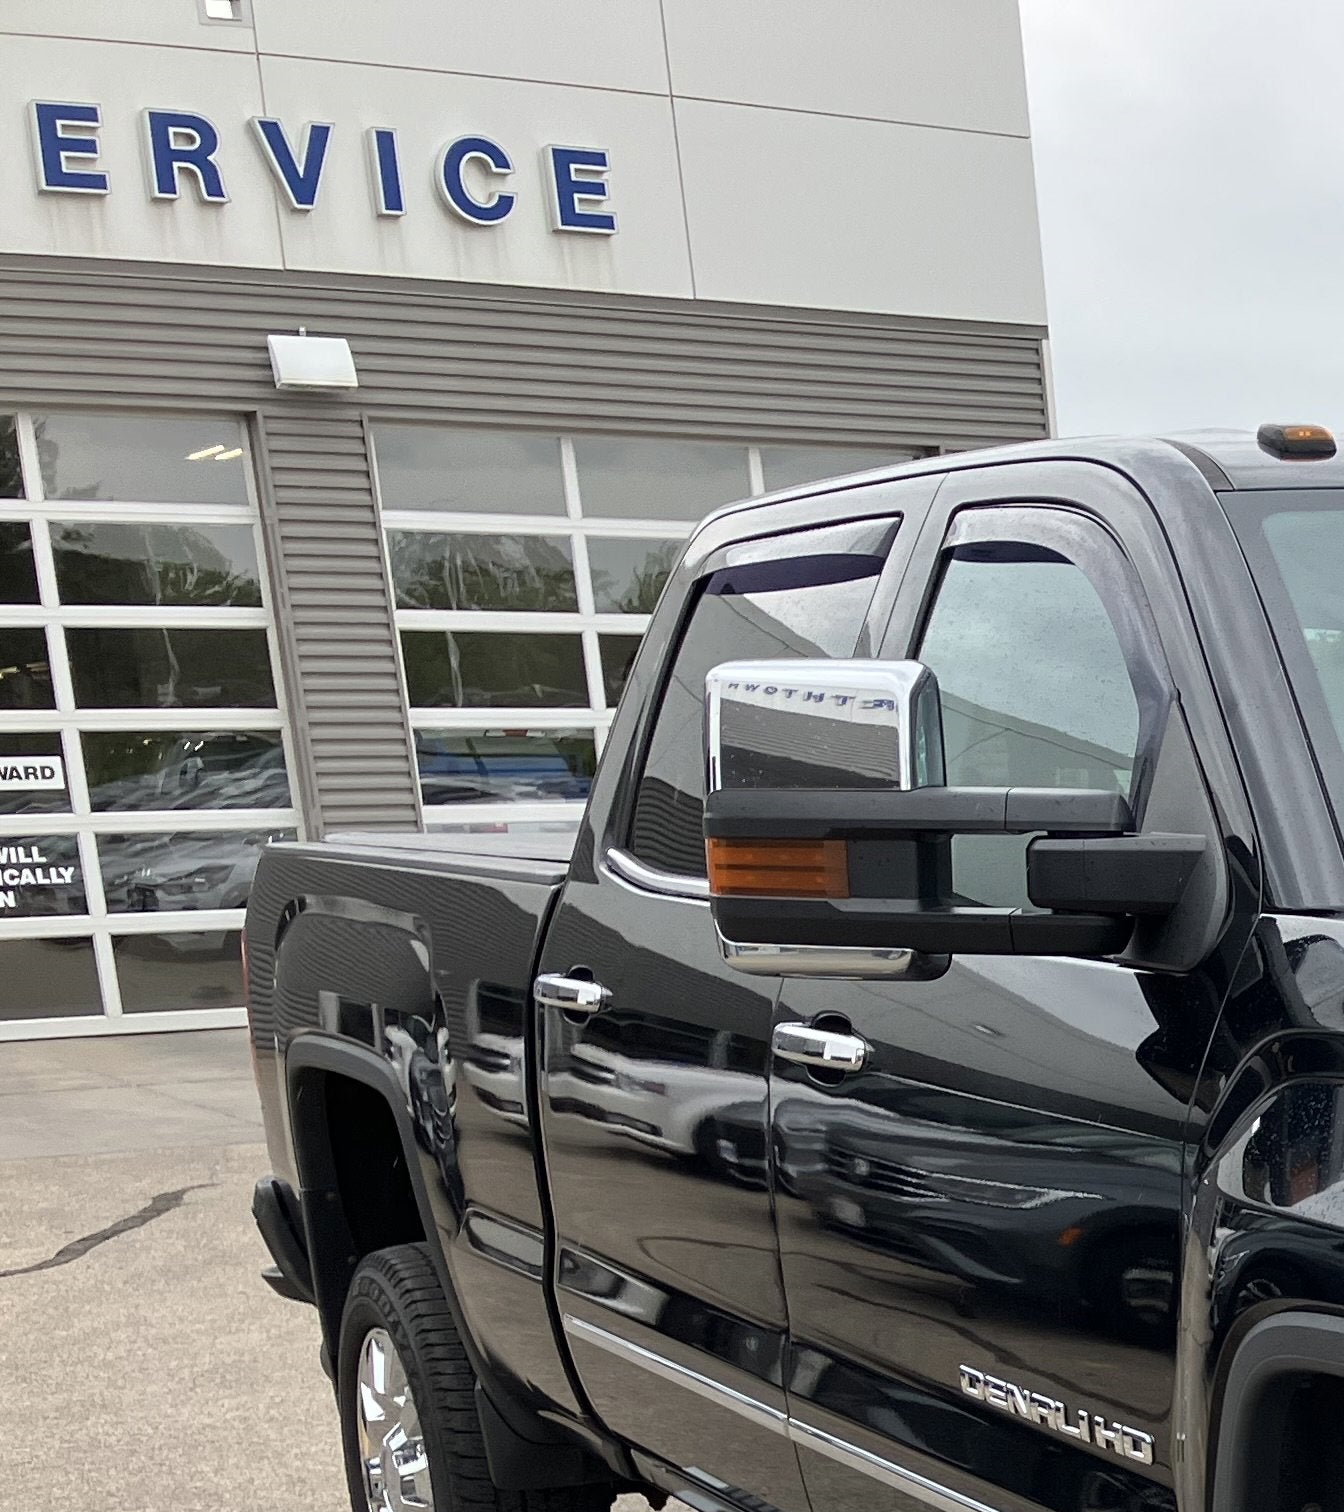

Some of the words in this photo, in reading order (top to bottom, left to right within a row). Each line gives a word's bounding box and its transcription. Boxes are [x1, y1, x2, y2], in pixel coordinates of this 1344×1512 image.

[27, 98, 619, 236] ERVICE
[959, 1364, 1091, 1443] DENALI
[1094, 1415, 1155, 1466] HD
